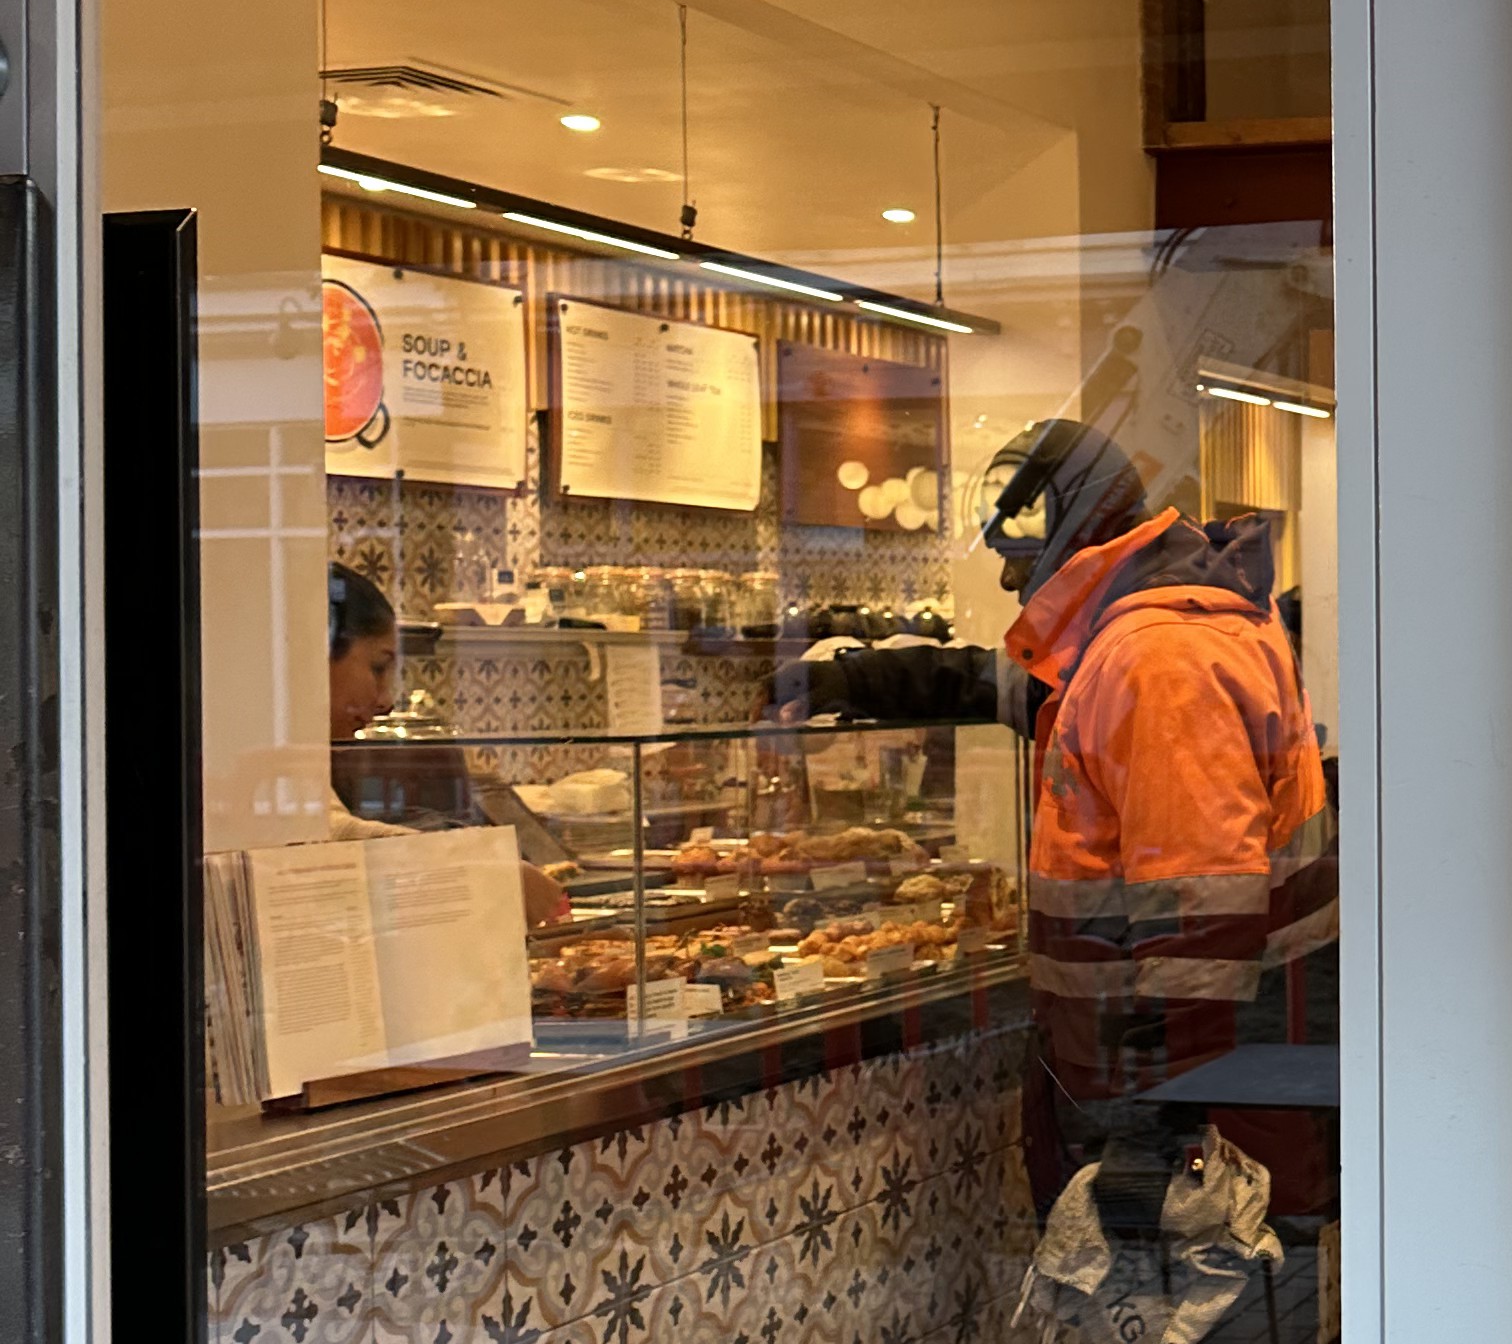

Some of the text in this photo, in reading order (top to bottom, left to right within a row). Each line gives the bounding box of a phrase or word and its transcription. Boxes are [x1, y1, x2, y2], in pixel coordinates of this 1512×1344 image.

[402, 333, 467, 361] SOUP &
[403, 359, 493, 389] FOCACCIA
[1105, 1291, 1146, 1344] KG
